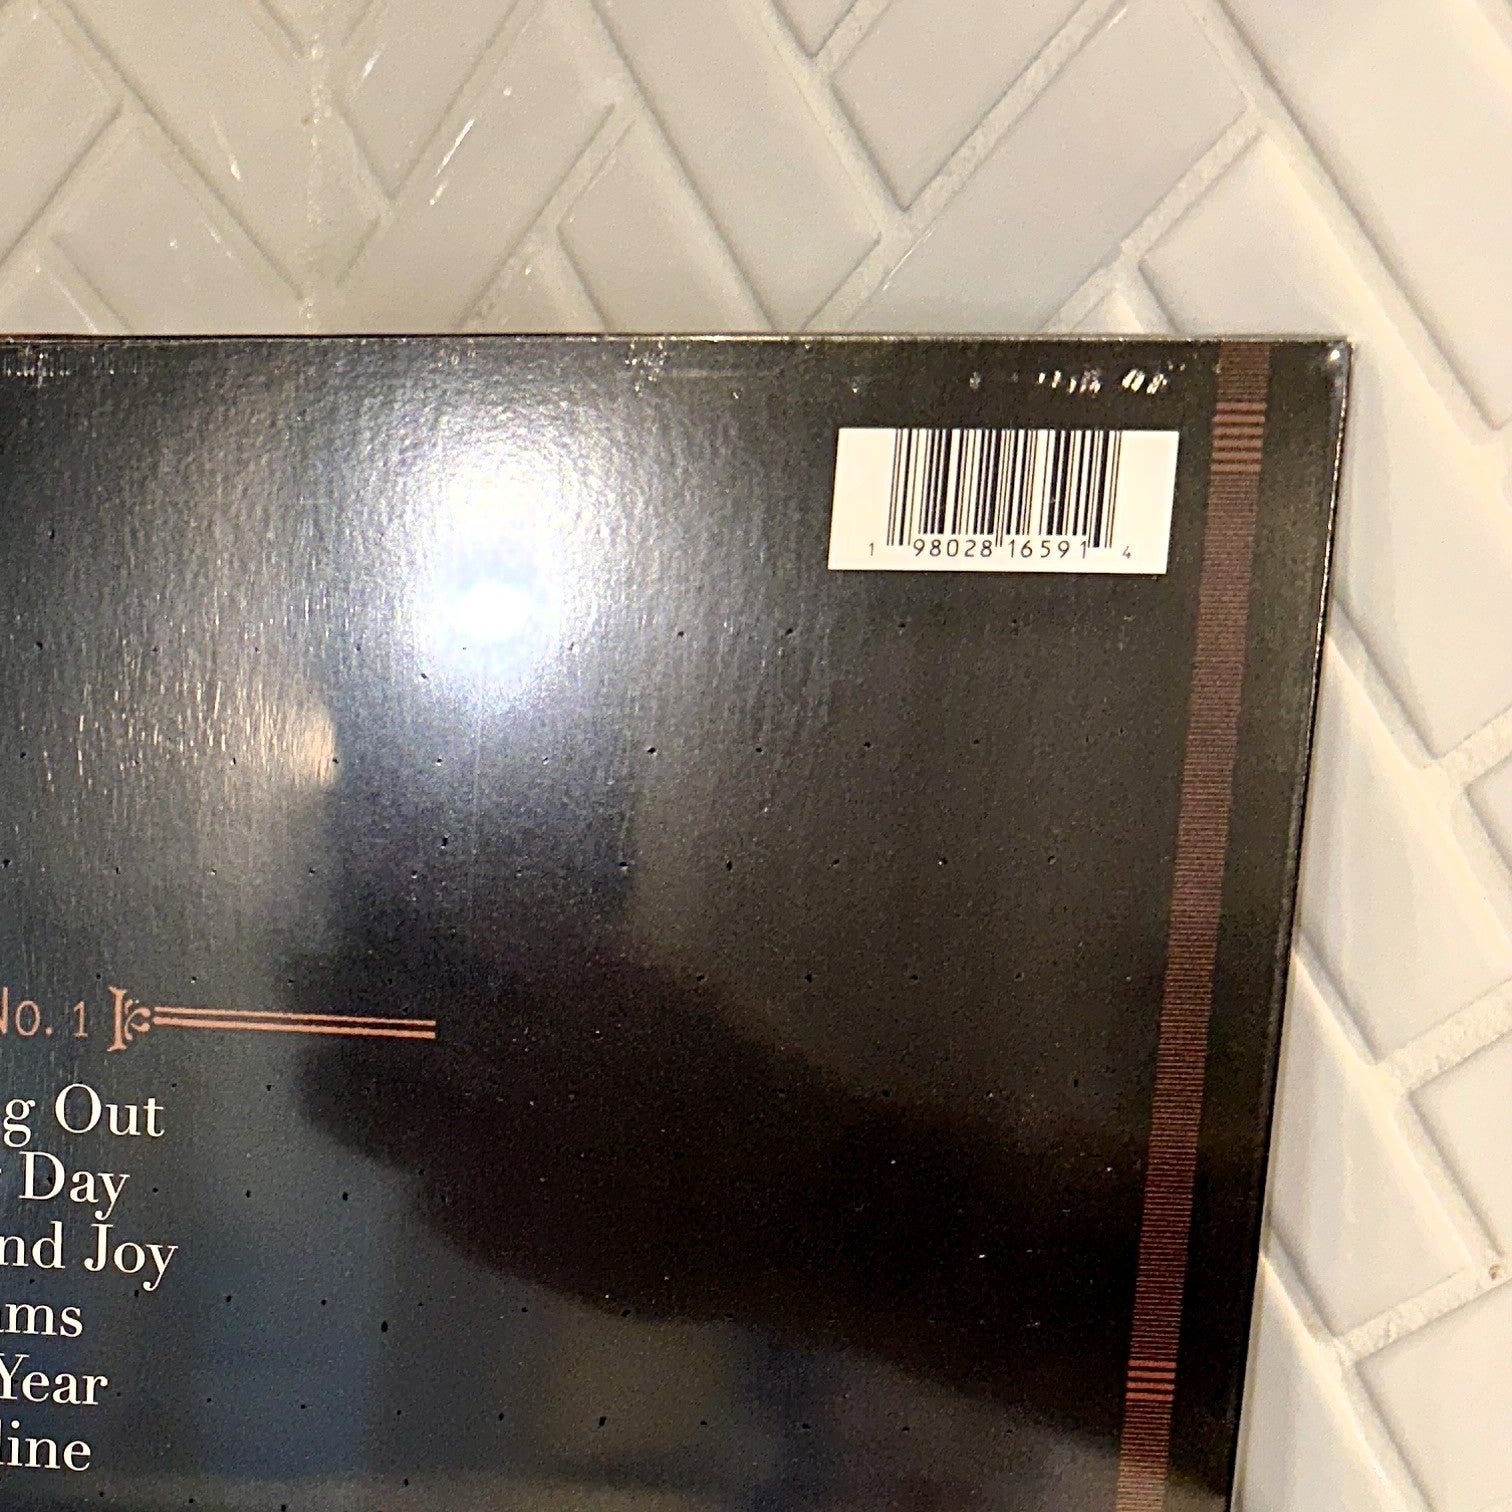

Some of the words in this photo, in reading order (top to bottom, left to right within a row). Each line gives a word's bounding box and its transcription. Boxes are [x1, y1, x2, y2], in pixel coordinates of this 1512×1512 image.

[868, 542, 875, 557] 1
[912, 538, 993, 558] 98028
[1008, 539, 1088, 560] 16591
[1122, 544, 1132, 560] 4
[73, 1001, 89, 1038] 1
[55, 1083, 165, 1138] Out
[22, 1151, 130, 1220] Day
[85, 1225, 178, 1290] Joy
